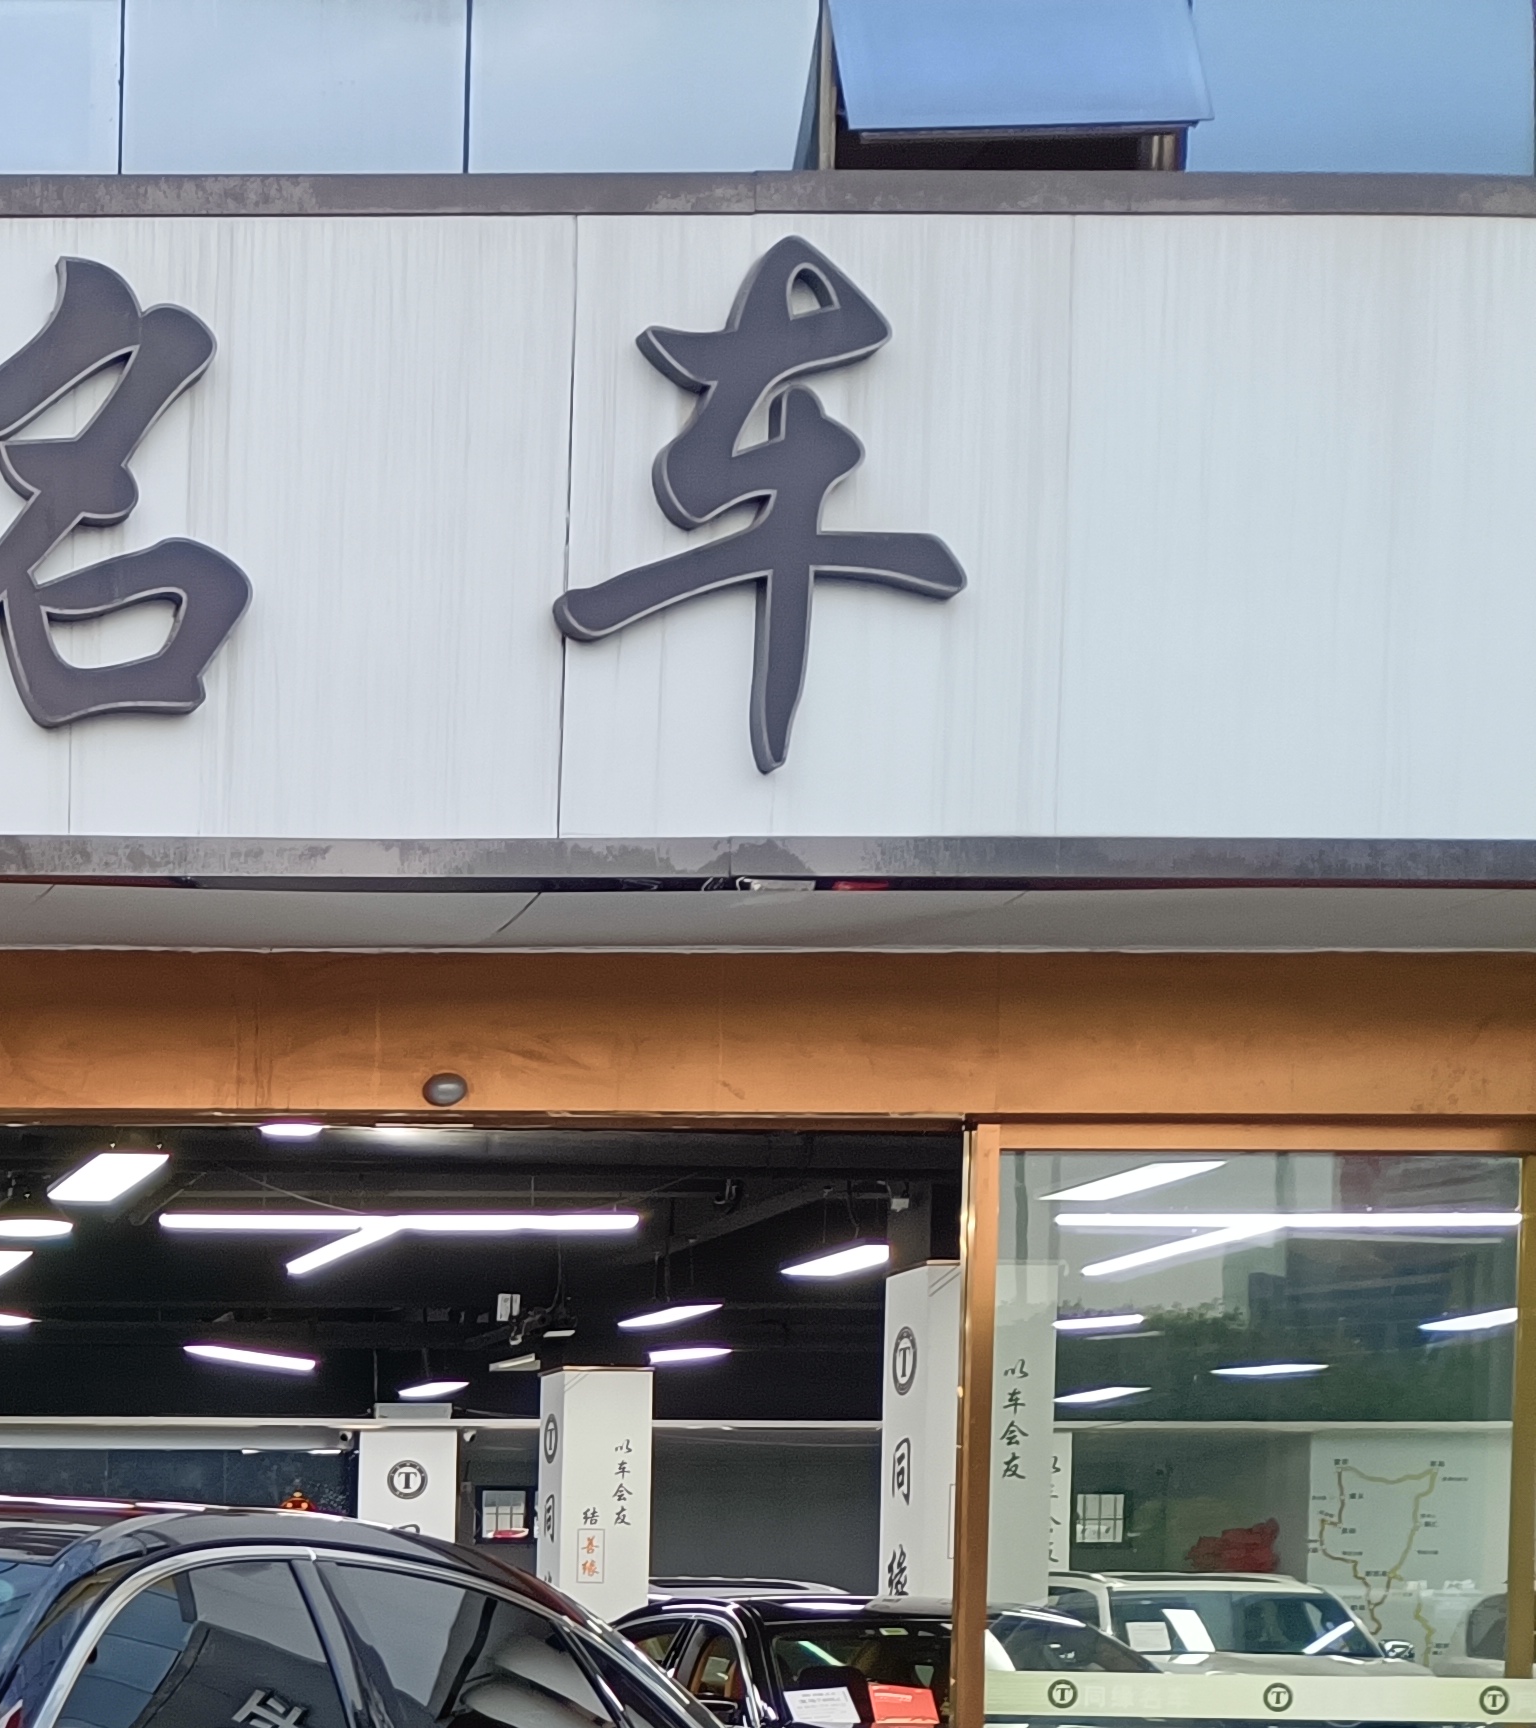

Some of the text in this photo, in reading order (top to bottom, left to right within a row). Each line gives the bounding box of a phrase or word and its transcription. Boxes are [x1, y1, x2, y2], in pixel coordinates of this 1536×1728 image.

[999, 1358, 1029, 1480] 以车会友
[612, 1438, 633, 1526] 以车会友
